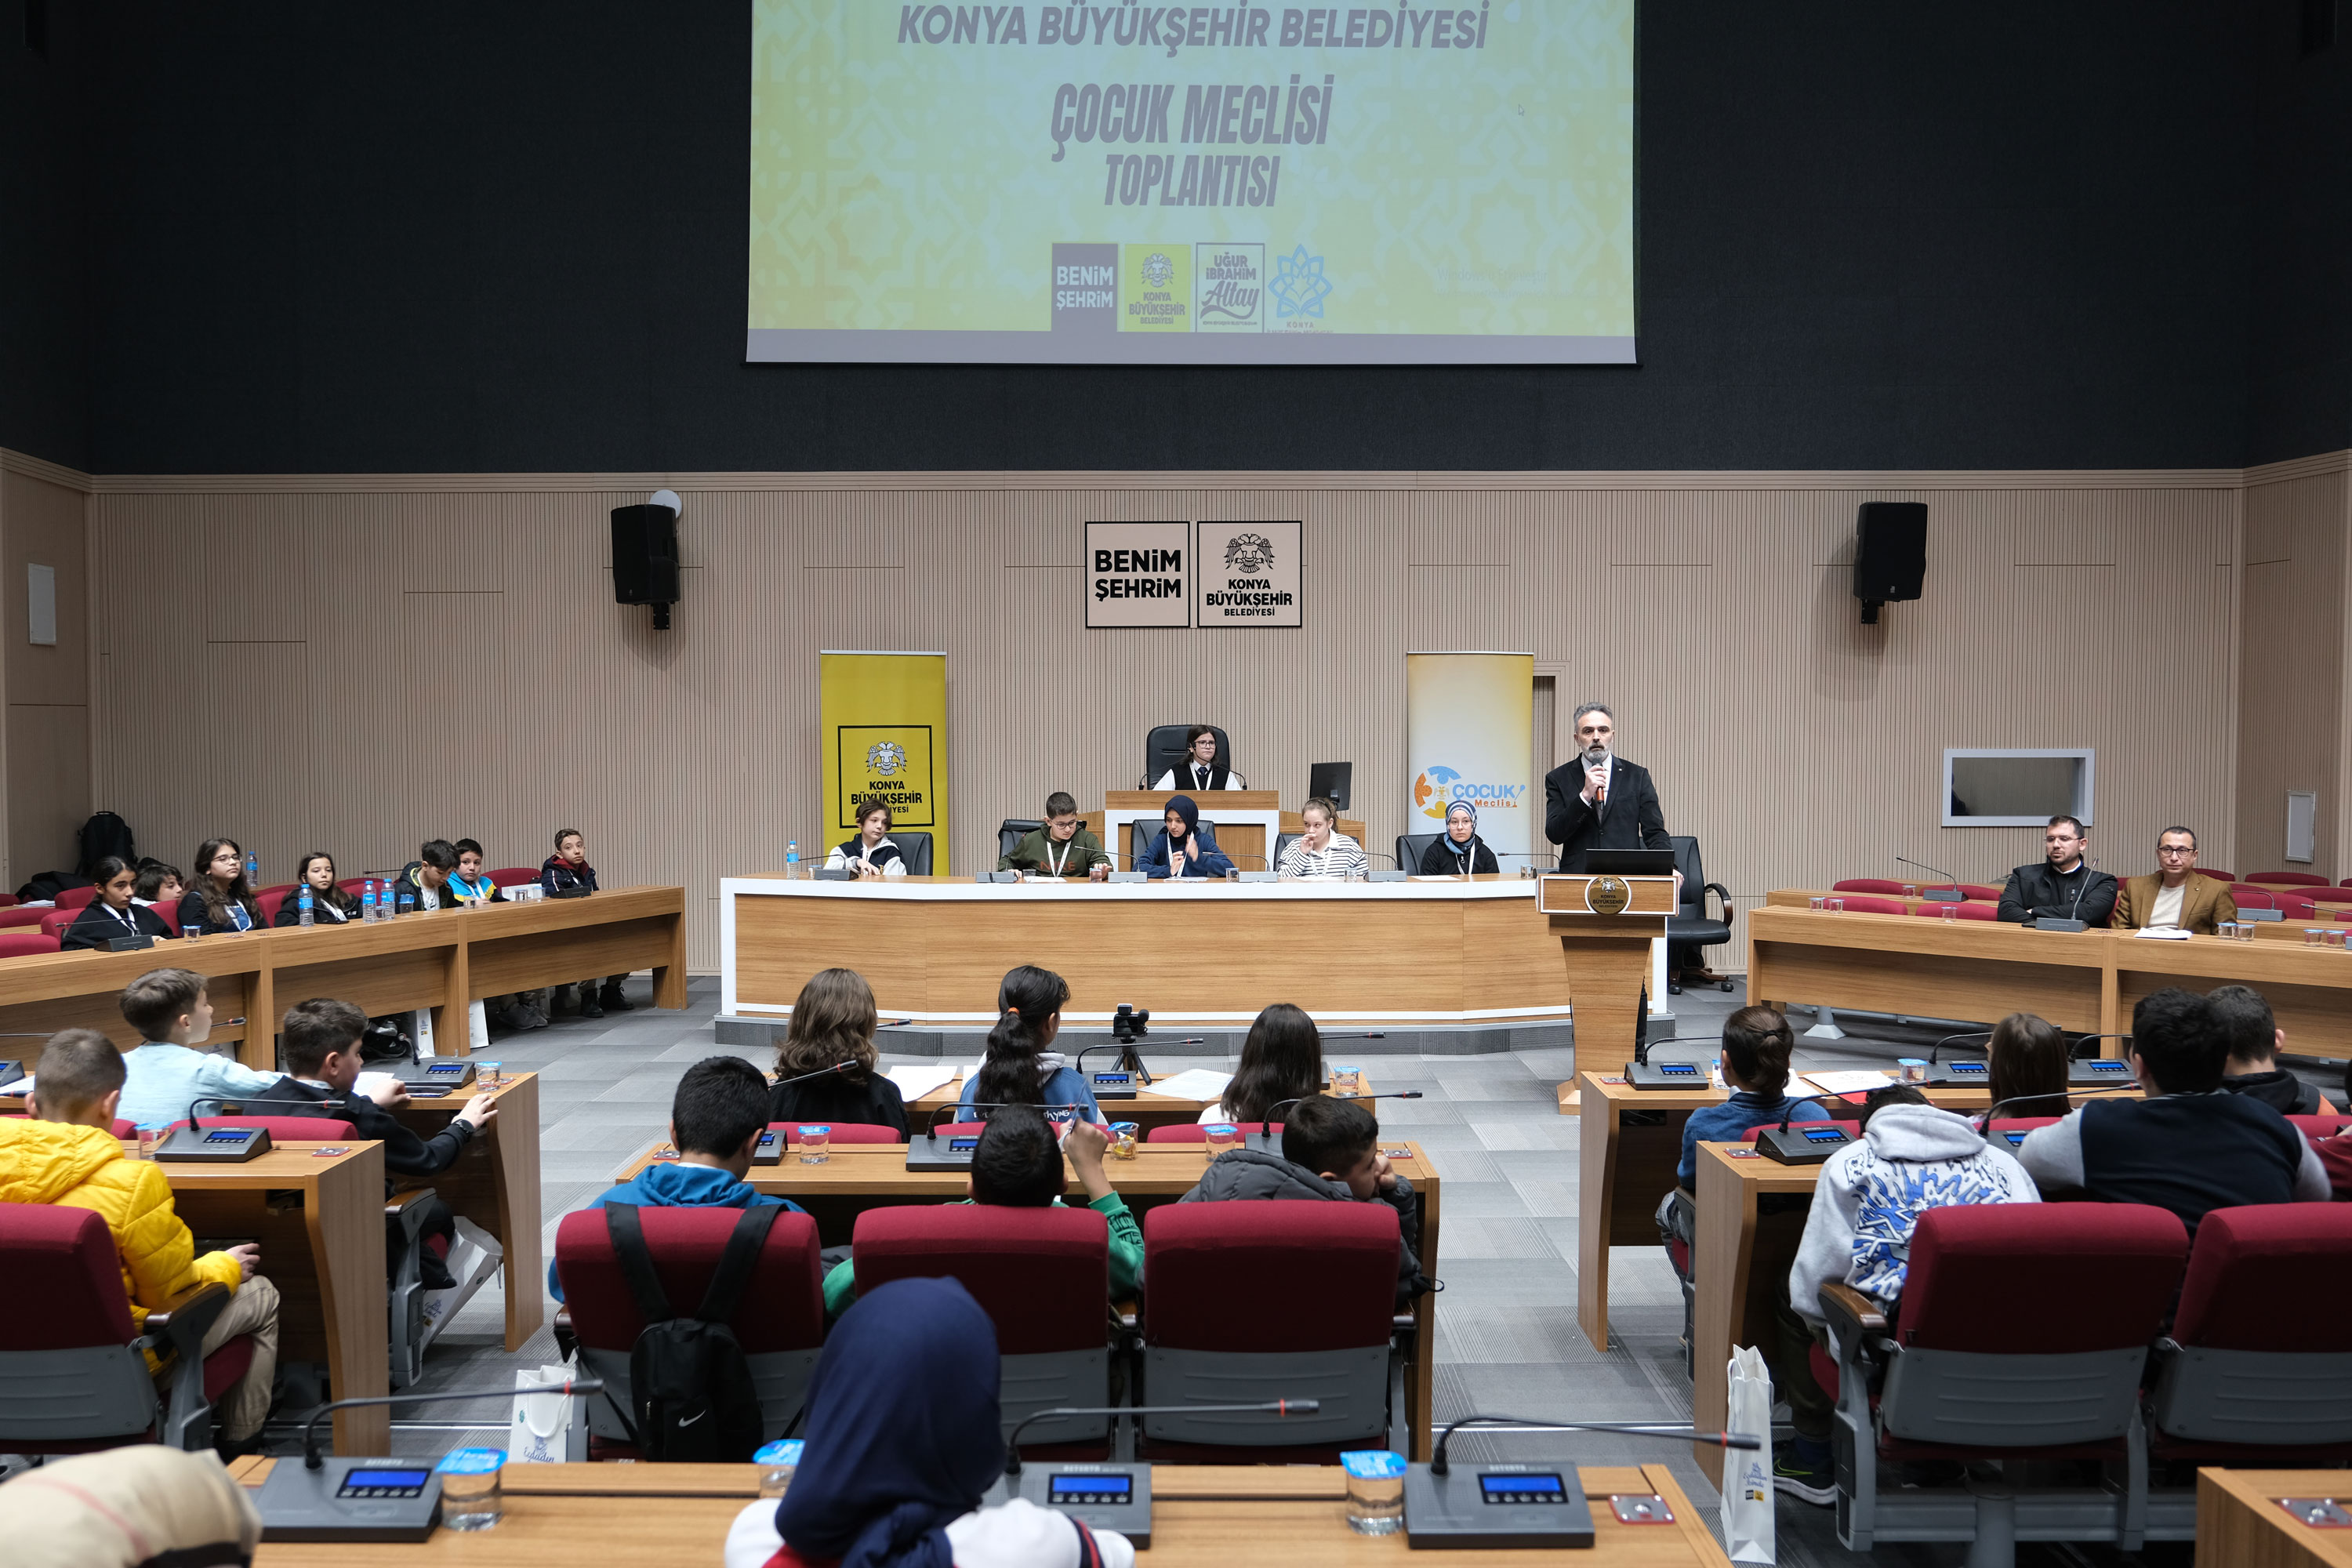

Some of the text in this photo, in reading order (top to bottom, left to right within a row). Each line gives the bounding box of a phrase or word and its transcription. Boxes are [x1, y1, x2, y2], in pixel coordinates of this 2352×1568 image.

[898, 0, 1490, 58] KONYA BÜYÜKŞEHİR BELEDİYESİ
[1051, 74, 1334, 162] ÇOCUK MECLİSİ
[1104, 154, 1280, 207] TOPLANTISI
[1214, 252, 1248, 268] UĞUR
[1143, 292, 1171, 302] KONYA
[1200, 280, 1260, 320] Altay
[1128, 301, 1185, 318] BÜYÜKŞEHİR
[1228, 579, 1271, 590] KONYA
[1206, 590, 1293, 608] BÜYÜKŞEHİR
[1224, 606, 1275, 616] BELEDİYESİ
[869, 781, 906, 790] KONYA
